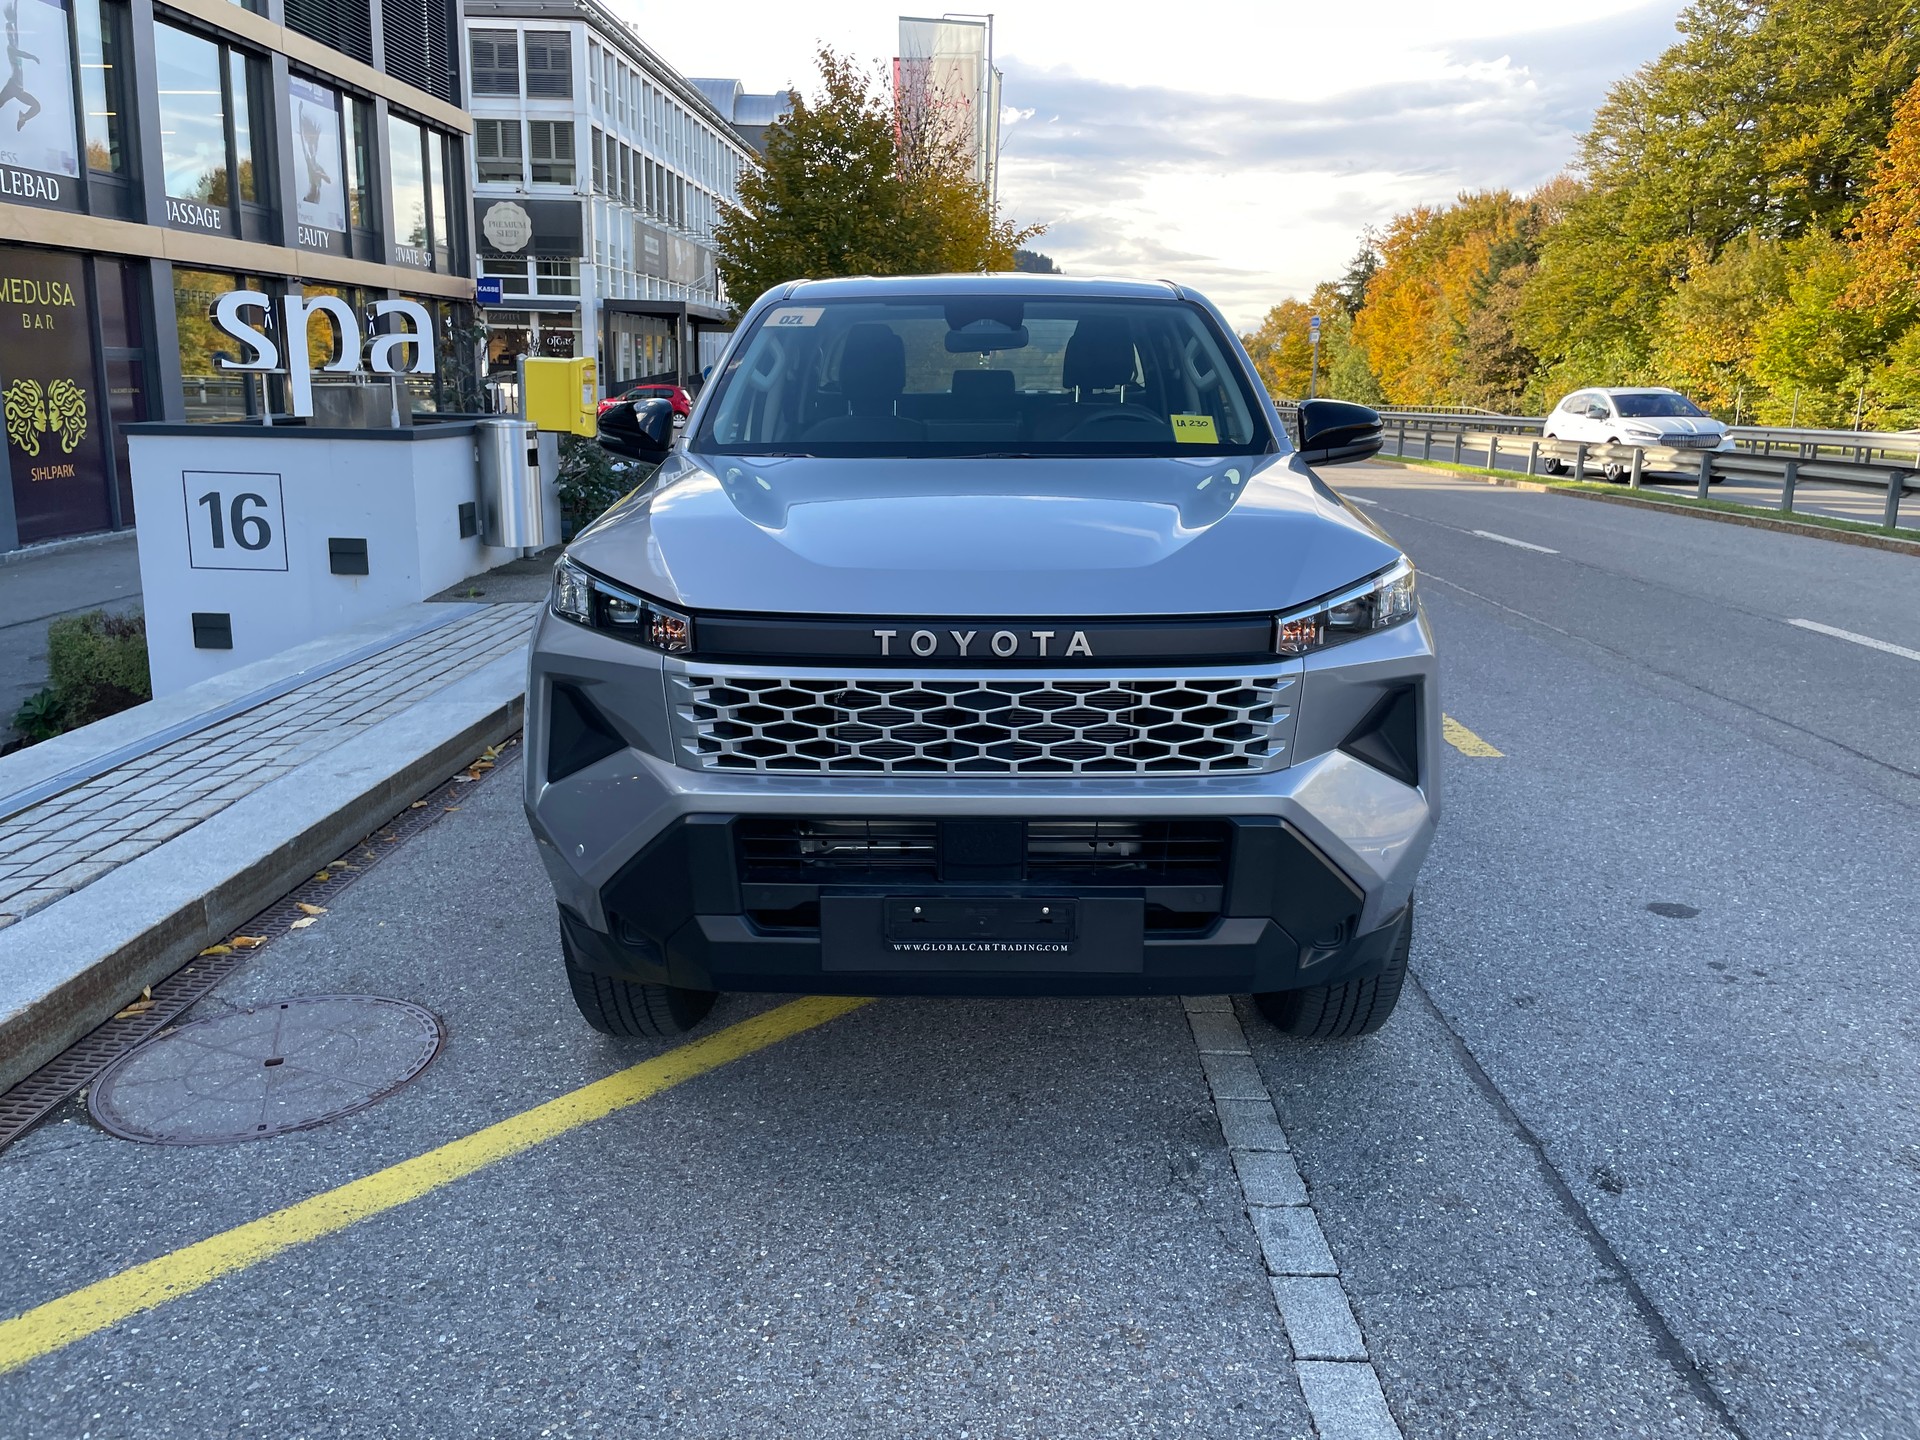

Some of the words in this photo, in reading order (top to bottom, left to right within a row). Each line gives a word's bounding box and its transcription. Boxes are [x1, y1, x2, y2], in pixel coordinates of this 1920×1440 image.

[166, 200, 221, 229] ASSAGE
[0, 278, 76, 307] MEDUSA
[478, 285, 500, 293] KASSE
[22, 313, 55, 330] BAR
[209, 290, 436, 417] spa
[1189, 419, 1209, 427] 230
[31, 463, 76, 482] SIHLPARK
[198, 491, 272, 551] 16
[873, 629, 1094, 657] TOYOTA
